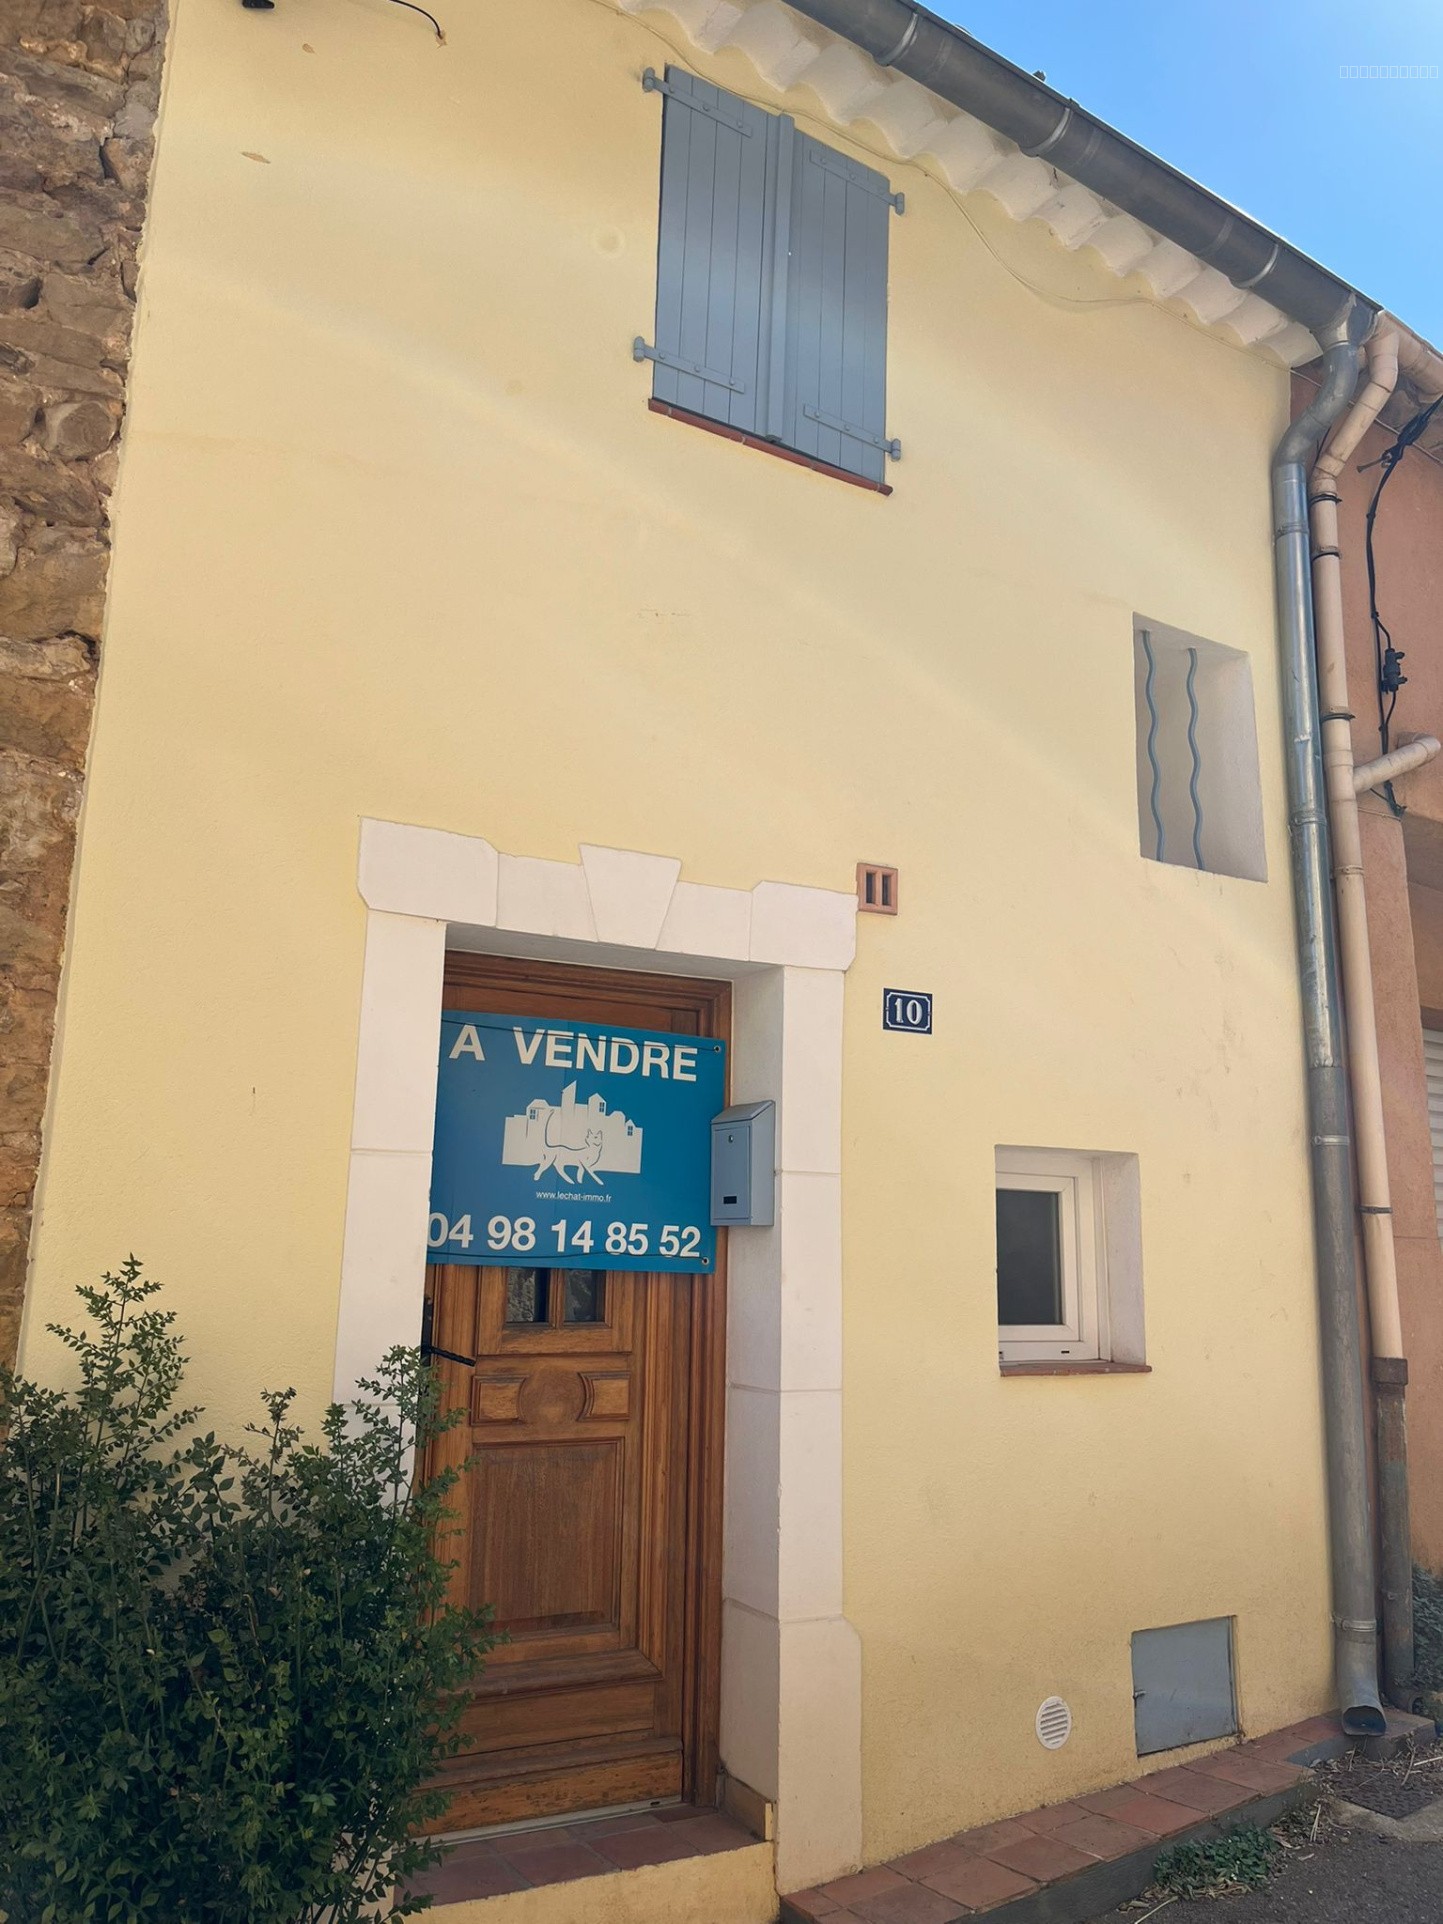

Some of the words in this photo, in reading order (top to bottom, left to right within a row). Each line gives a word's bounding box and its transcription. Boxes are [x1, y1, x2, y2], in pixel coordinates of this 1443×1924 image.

[894, 997, 923, 1025] 10
[448, 1023, 486, 1062] A
[512, 1026, 699, 1083] VENDRE
[535, 1190, 612, 1203] www.lechat-immo.fr
[427, 1212, 474, 1249] 04
[487, 1215, 537, 1252] 98
[551, 1219, 595, 1254] 14
[605, 1222, 649, 1257] 85
[658, 1225, 702, 1259] 52
